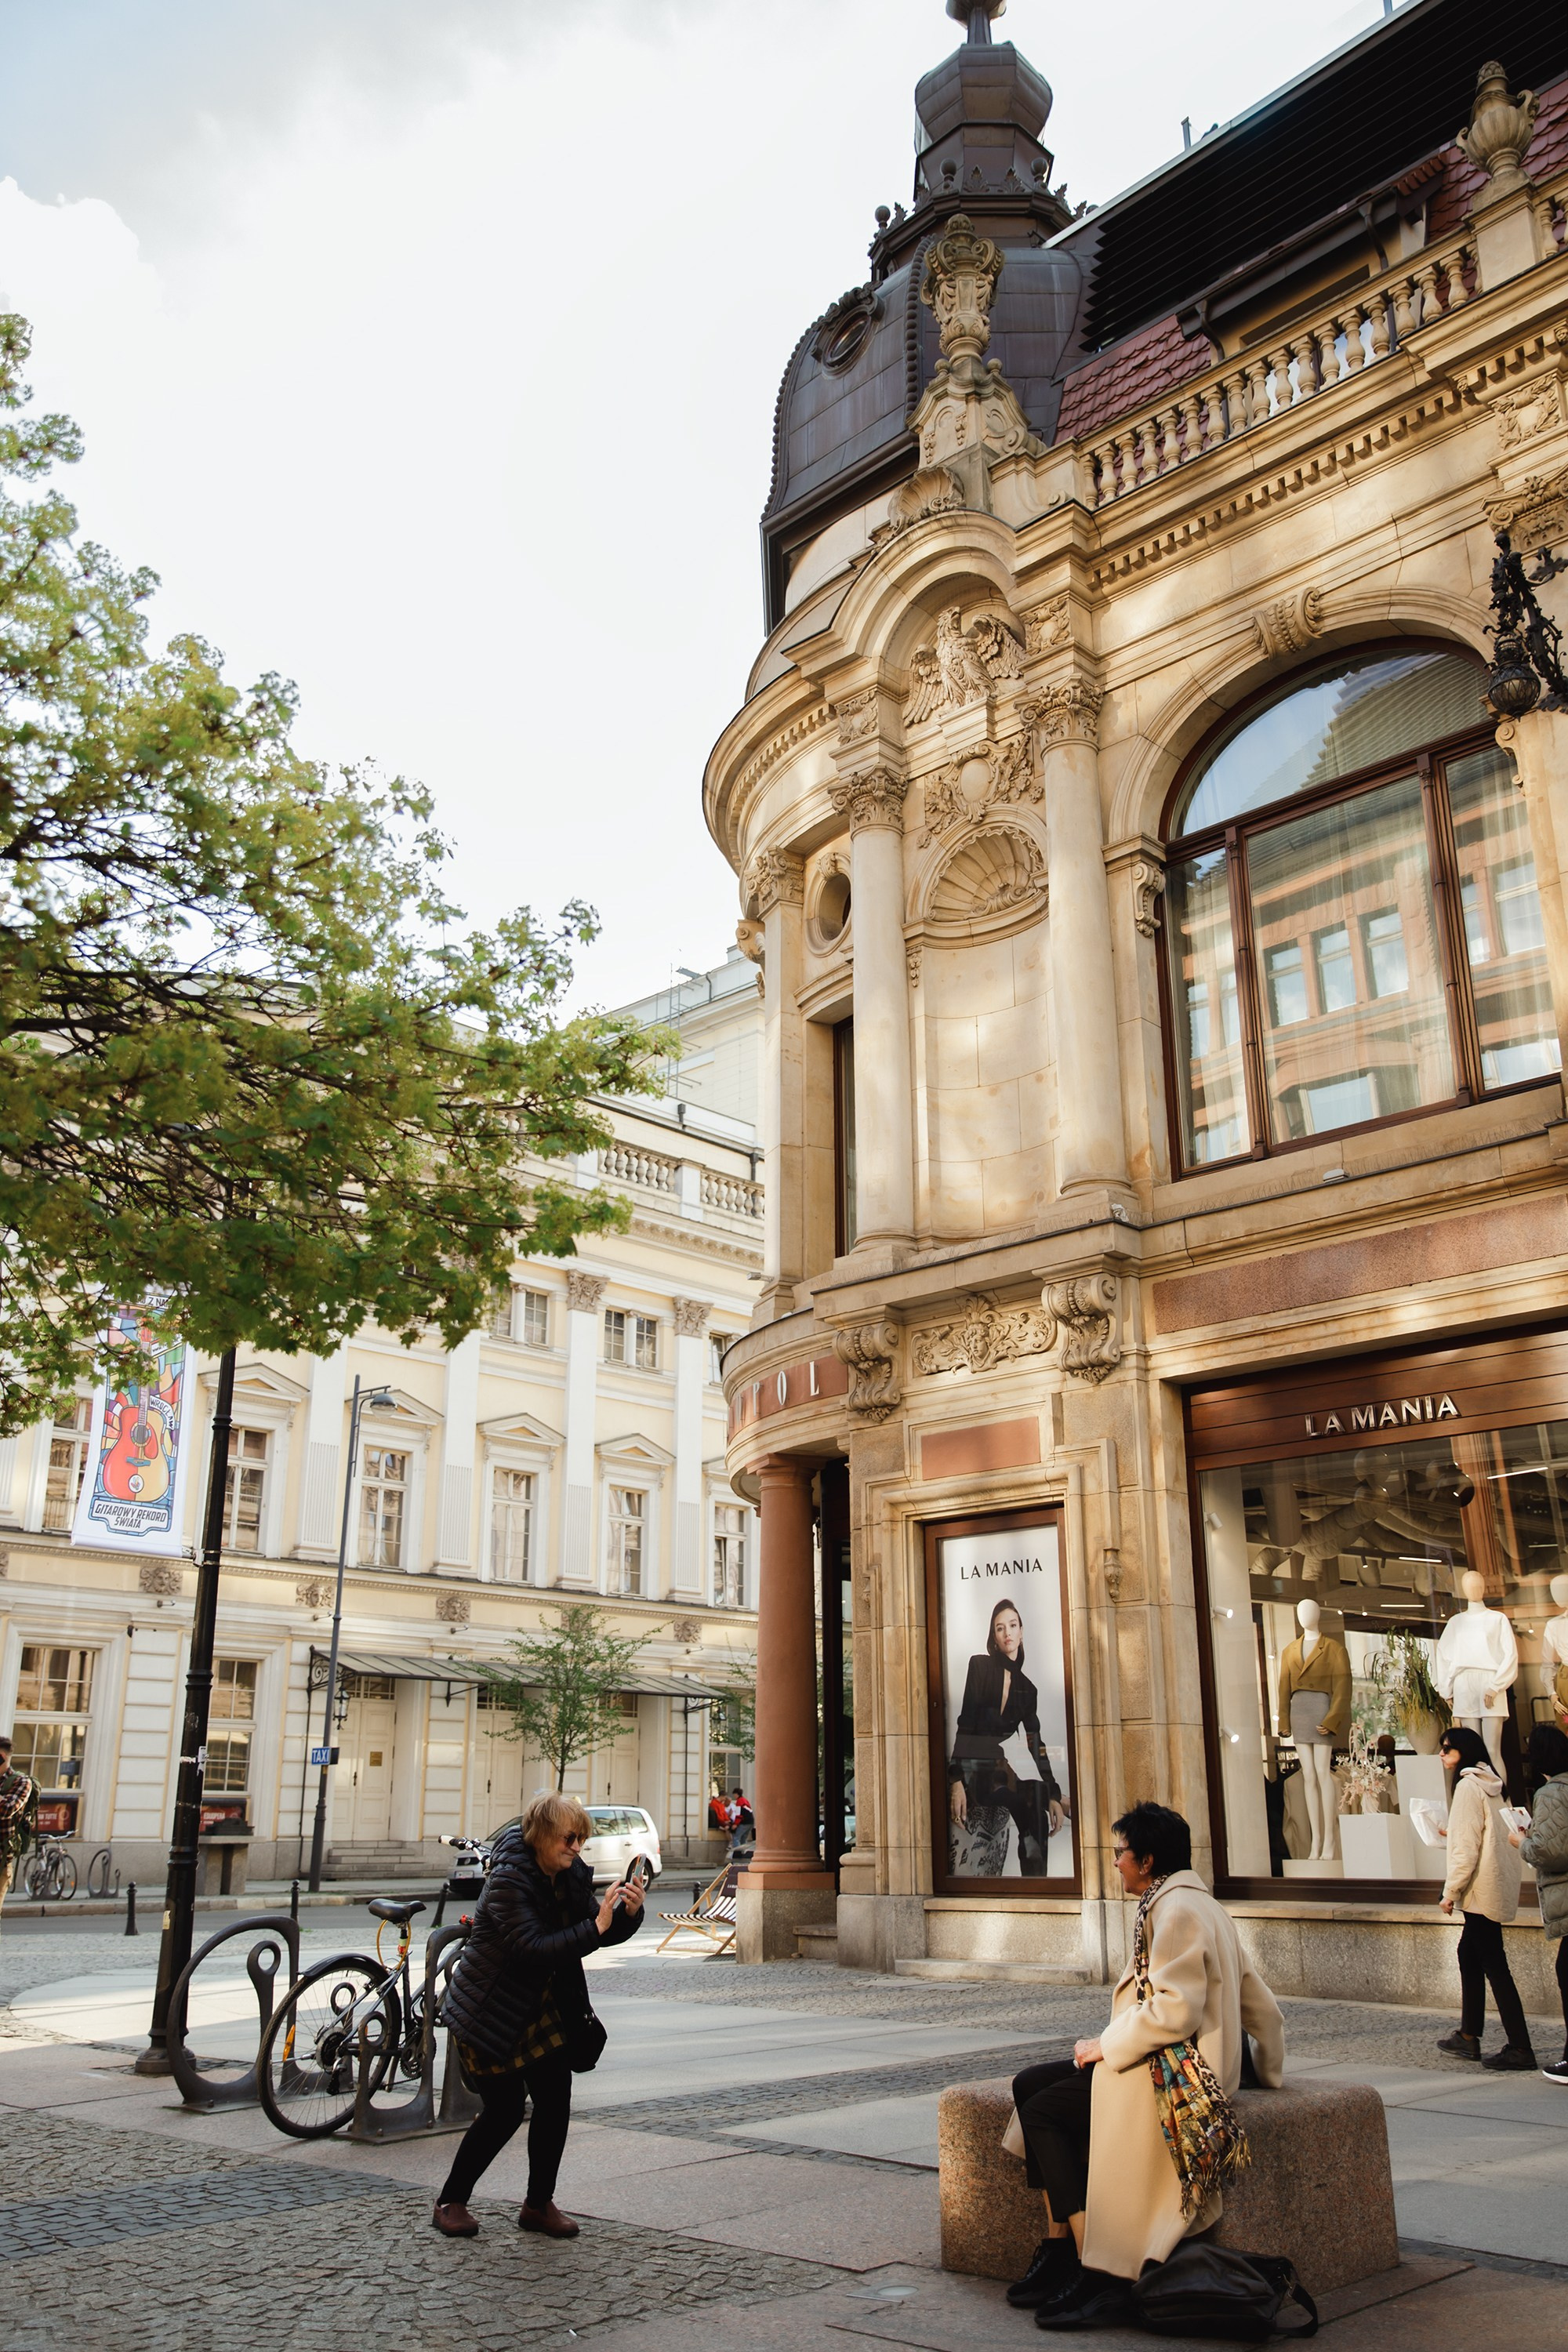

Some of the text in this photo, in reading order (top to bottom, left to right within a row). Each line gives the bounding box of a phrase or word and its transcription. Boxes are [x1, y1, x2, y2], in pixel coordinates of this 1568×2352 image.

[1305, 1394, 1459, 1436] LA MANIA
[95, 1504, 167, 1523] GITAROWY REKORD
[961, 1558, 1043, 1580] LA MANIA
[313, 1749, 329, 1762] TAXI
